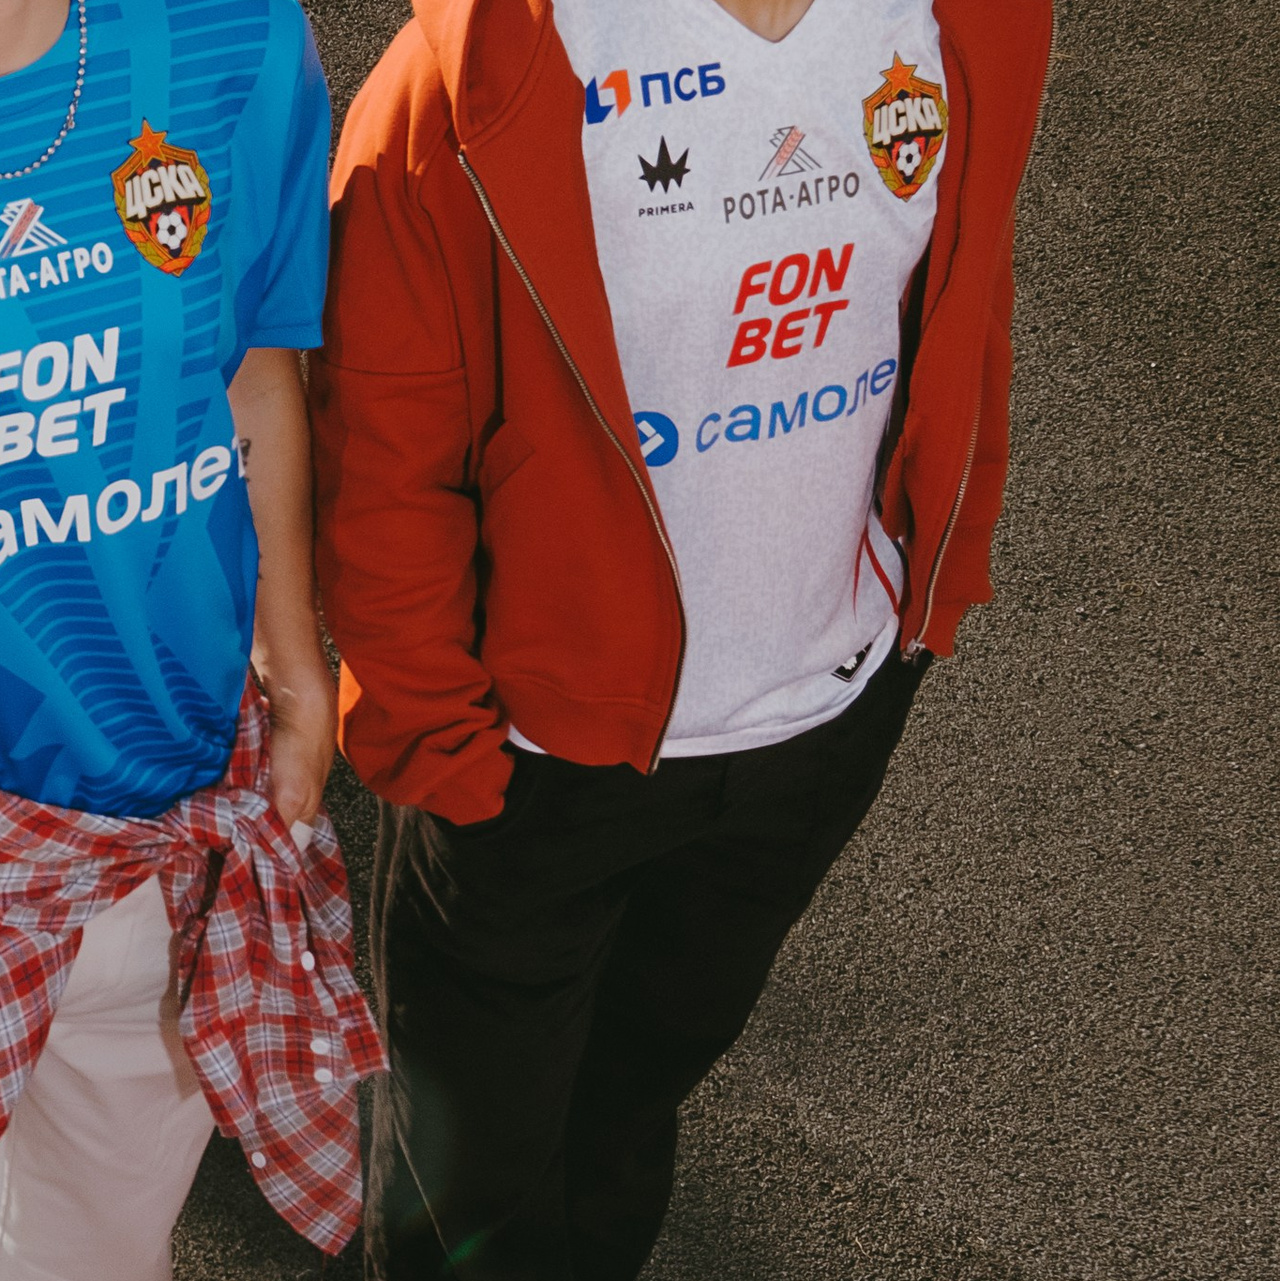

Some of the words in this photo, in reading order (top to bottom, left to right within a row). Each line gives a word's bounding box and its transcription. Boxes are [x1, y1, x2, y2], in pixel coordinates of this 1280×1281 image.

[640, 62, 726, 108] ПСБ
[872, 96, 942, 146] ЦСКА
[124, 163, 207, 220] ЦСКА
[638, 201, 695, 218] PRIMERA
[731, 242, 856, 316] FON
[725, 299, 850, 370] BET
